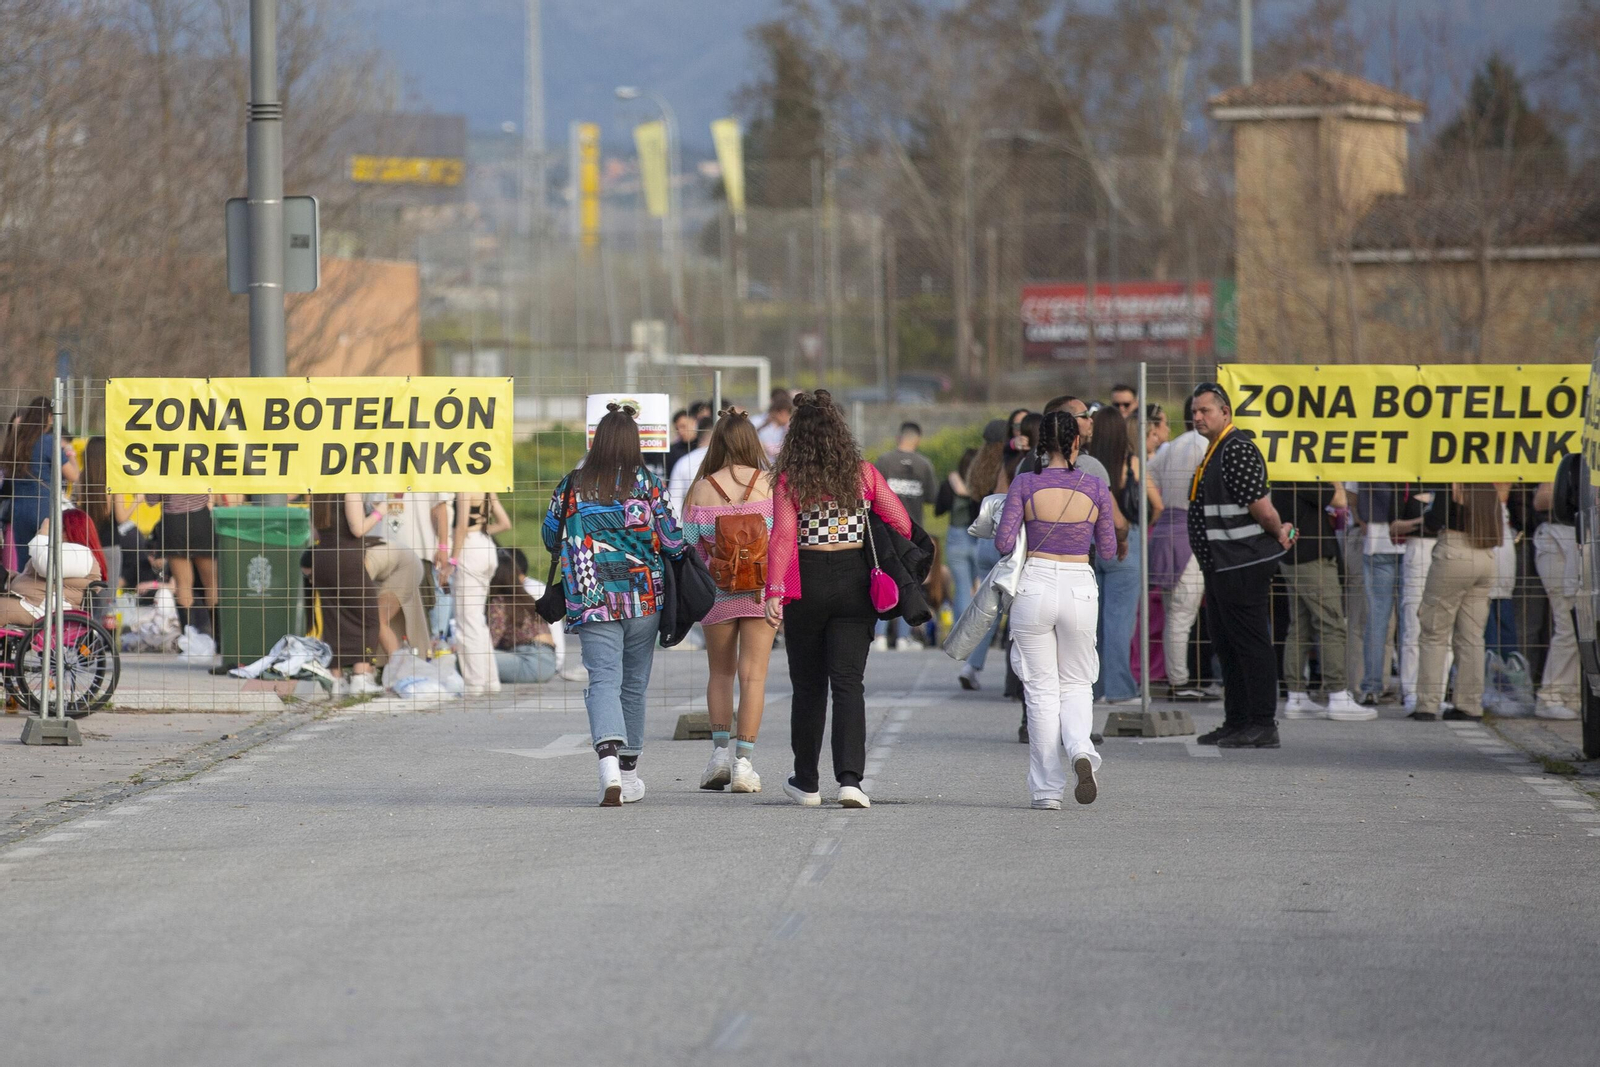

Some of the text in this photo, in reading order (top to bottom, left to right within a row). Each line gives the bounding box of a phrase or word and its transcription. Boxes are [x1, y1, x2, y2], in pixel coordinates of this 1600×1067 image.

[125, 388, 496, 432] ZONA BOTELLÓN
[1235, 384, 1357, 419] ZONA
[122, 441, 492, 476] STREET DRINKS
[1429, 430, 1583, 465] DRINK
